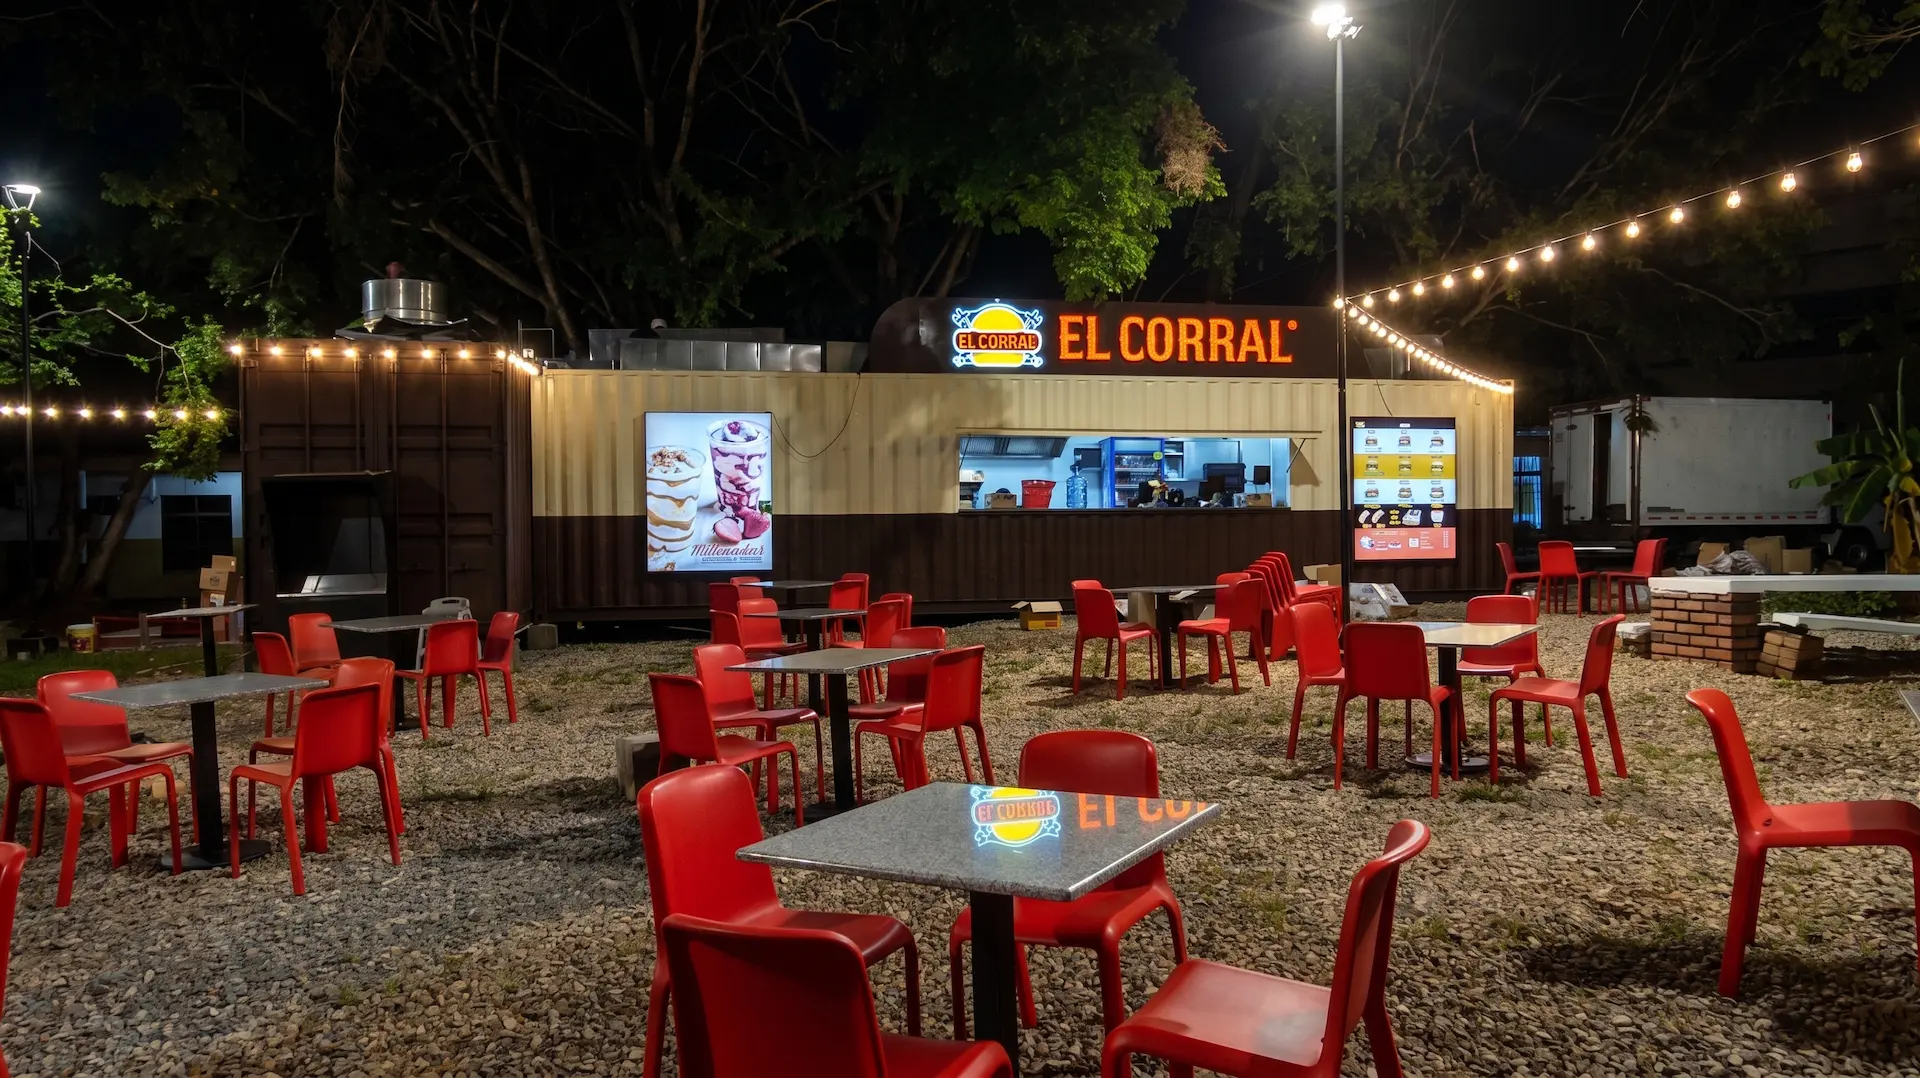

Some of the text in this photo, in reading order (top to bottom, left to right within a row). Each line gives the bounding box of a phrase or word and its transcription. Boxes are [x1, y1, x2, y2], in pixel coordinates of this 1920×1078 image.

[958, 333, 1037, 350] EL CORRAL
[1058, 315, 1293, 363] EL CORRAL
